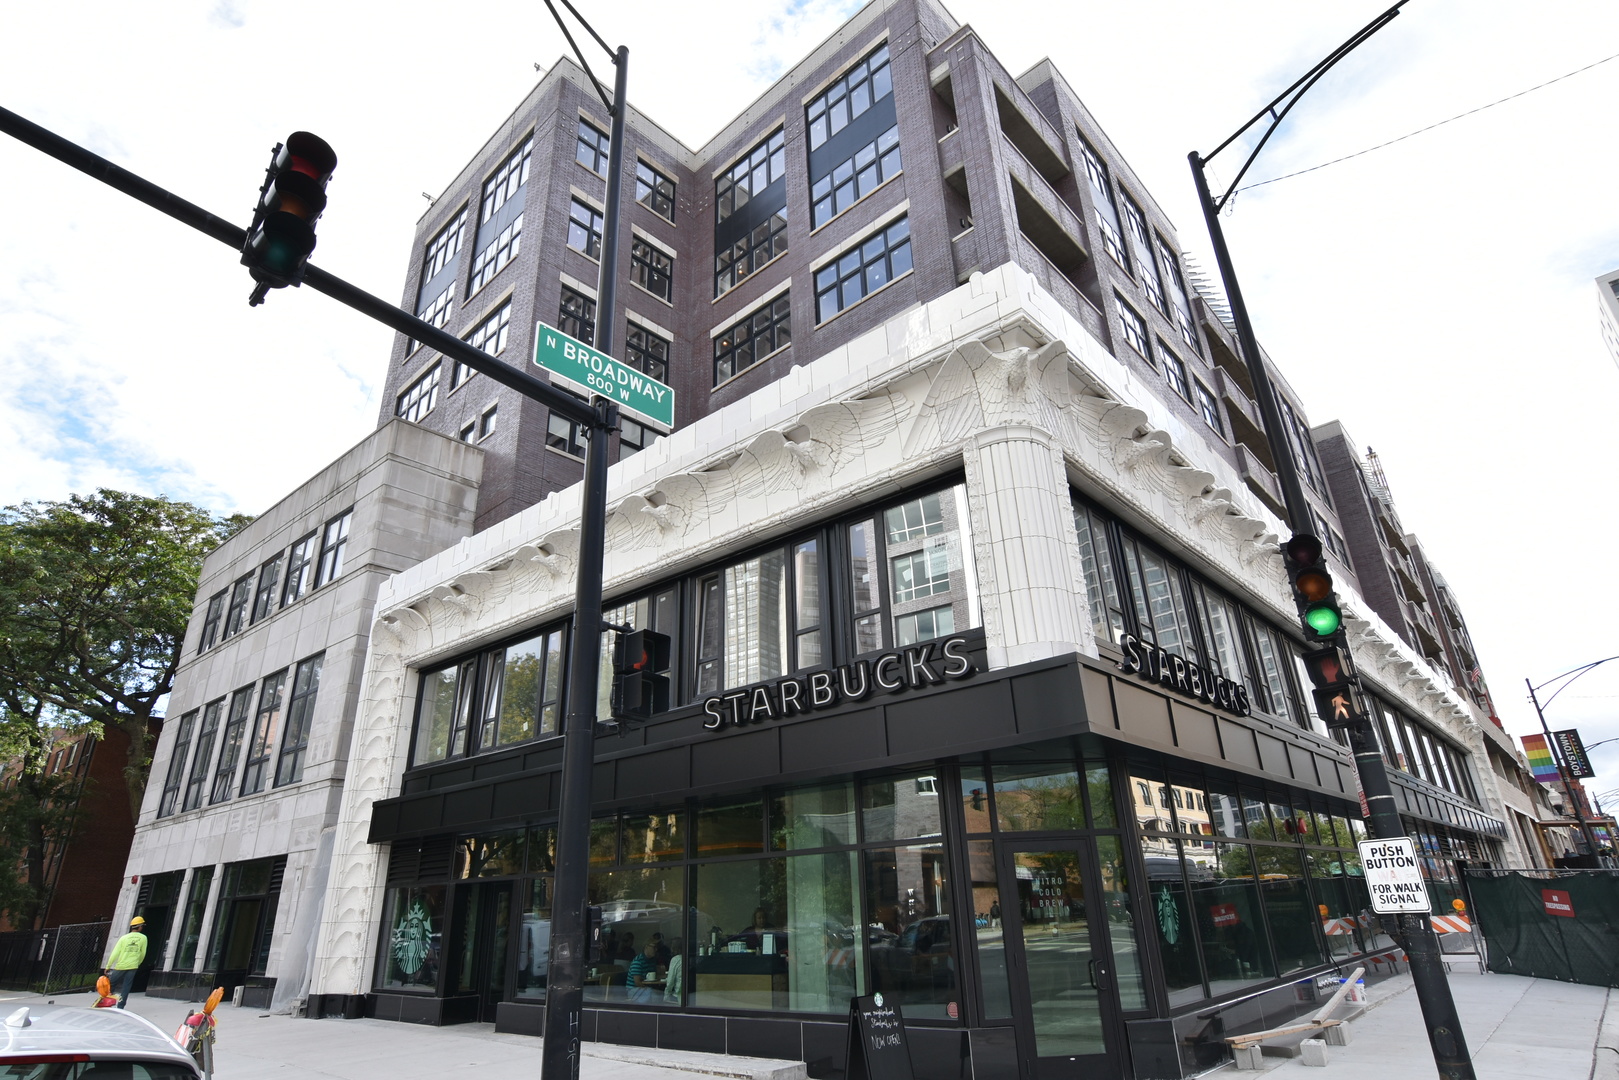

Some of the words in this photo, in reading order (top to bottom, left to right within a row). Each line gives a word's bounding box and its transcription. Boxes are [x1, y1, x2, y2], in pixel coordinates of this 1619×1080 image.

[546, 335, 556, 349] N
[563, 341, 666, 403] BROADWAY
[587, 373, 614, 393] 800
[619, 388, 630, 401] W
[1121, 633, 1251, 716] STARBUCKS
[703, 636, 972, 730] STARBUCKS
[1558, 733, 1582, 776] BOYSTOWN
[1370, 846, 1404, 857] PUSH
[1366, 857, 1414, 869] BUTTON
[1035, 877, 1063, 885] NITRO
[1372, 884, 1392, 894] FOR
[1393, 883, 1422, 892] WALK
[1039, 899, 1064, 907] BREW
[1379, 894, 1420, 904] SIGNAL
